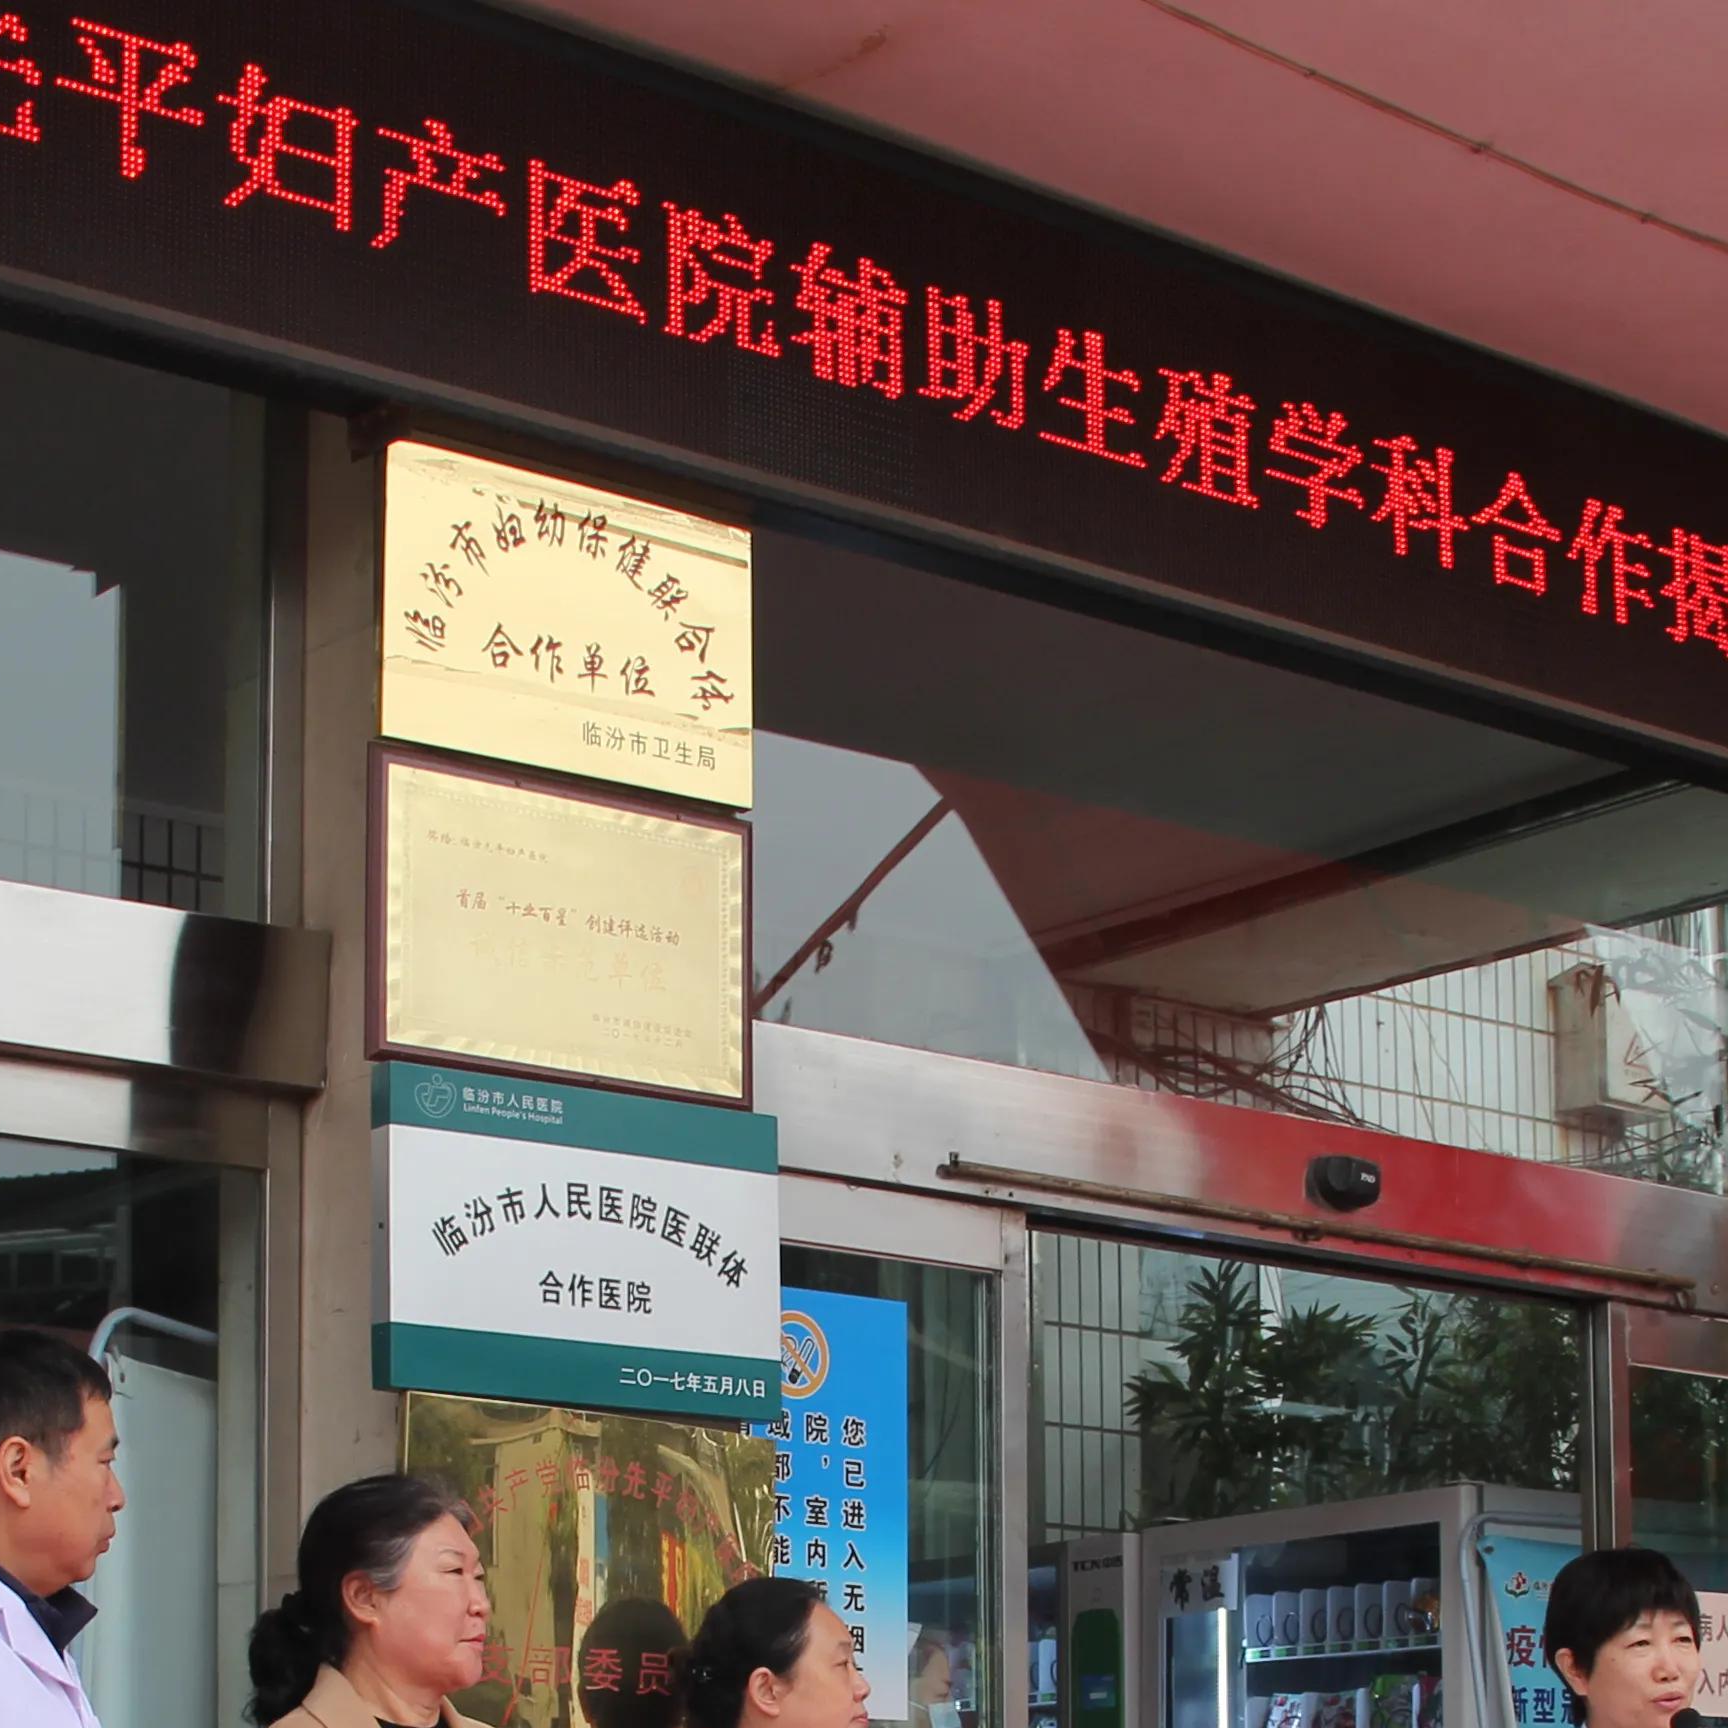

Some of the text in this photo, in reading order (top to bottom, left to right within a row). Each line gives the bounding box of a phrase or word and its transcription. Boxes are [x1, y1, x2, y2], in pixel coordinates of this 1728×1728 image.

[482, 623, 656, 698] 合作单位
[582, 721, 717, 771] 临汾市卫生局
[462, 1086, 564, 1115] 临汾市人民医院
[463, 1102, 563, 1125] Linfen People's Hospital
[431, 1182, 749, 1289] 临汾市人民医院医联体
[538, 1270, 653, 1315] 合作医院
[842, 1416, 866, 1671] 您已进入无烟
